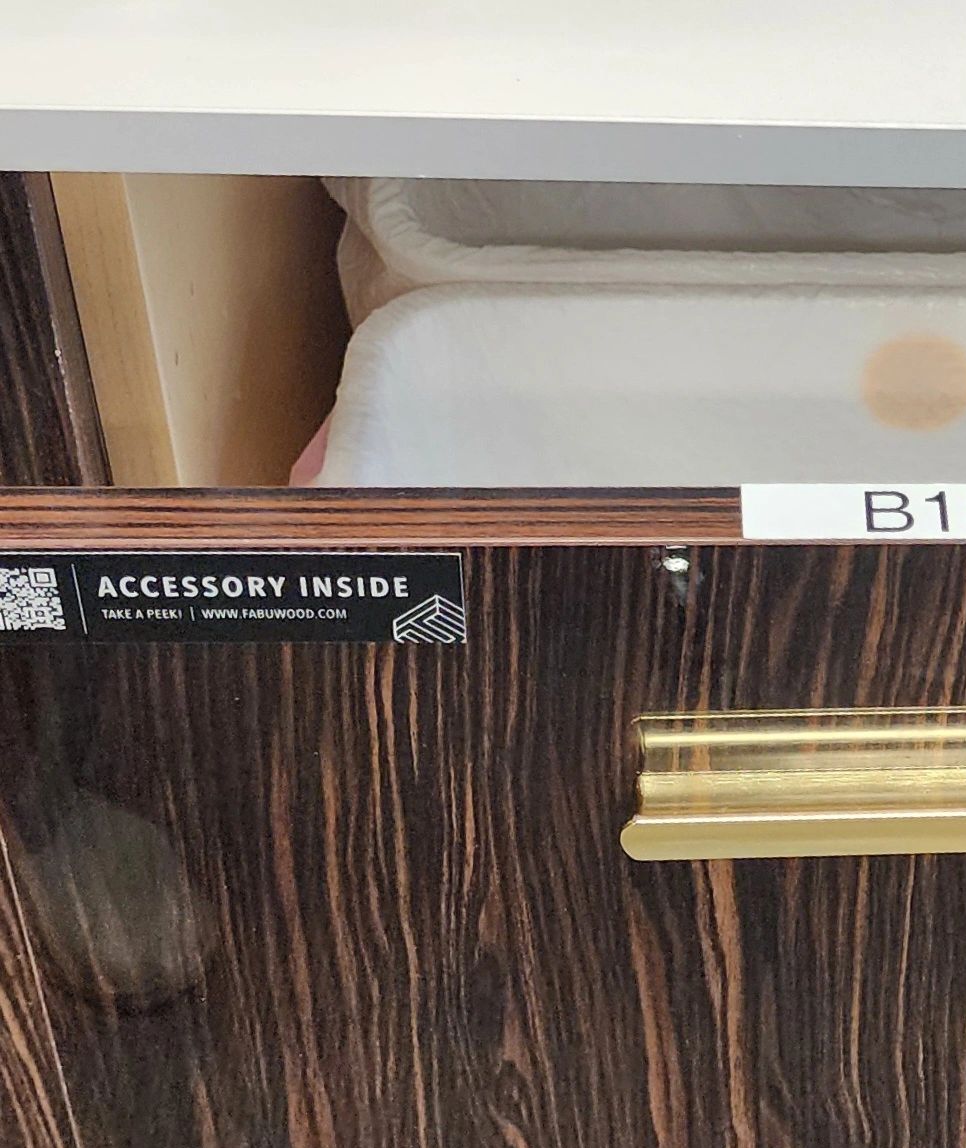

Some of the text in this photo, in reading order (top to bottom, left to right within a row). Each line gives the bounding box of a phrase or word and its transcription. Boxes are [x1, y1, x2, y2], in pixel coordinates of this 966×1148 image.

[98, 575, 410, 598] ACCESSORY INSIDE
[101, 608, 133, 620] TAKE
[134, 608, 145, 620] A
[201, 608, 348, 621] WWW.FABUWOOD.COM
